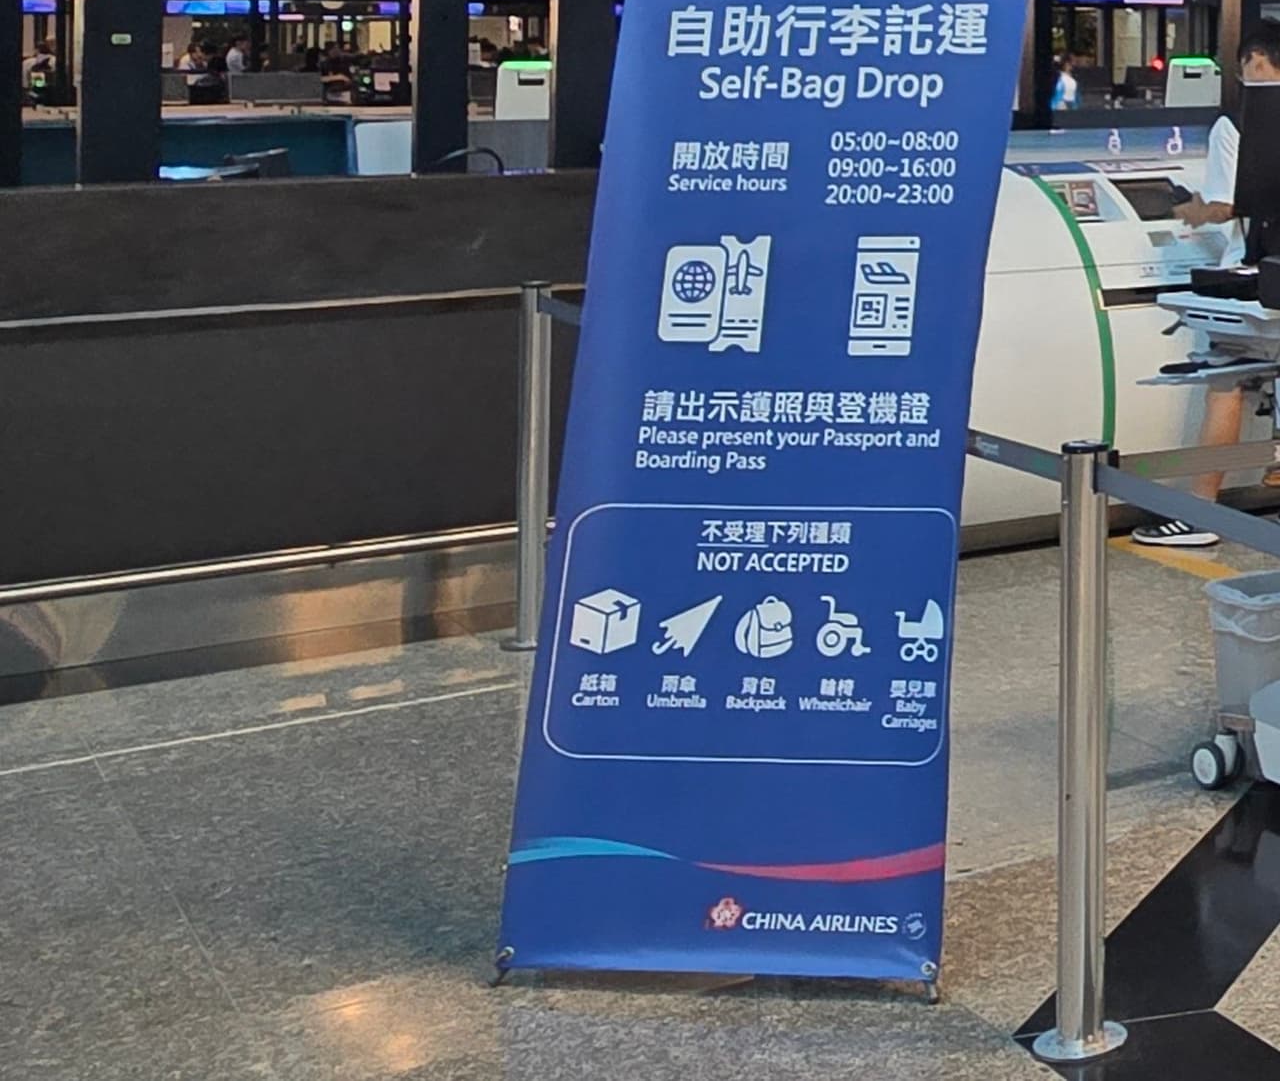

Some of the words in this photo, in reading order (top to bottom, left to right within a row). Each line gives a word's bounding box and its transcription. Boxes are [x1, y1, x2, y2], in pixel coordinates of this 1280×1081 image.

[667, 4, 989, 57] 自助行李託運
[699, 67, 845, 107] Self-Bag
[857, 69, 943, 107] Drop
[831, 131, 959, 151] 05:00~08:00
[672, 142, 790, 171] 開放時間
[828, 158, 956, 178] 09:00~16:00
[668, 174, 733, 192] Service
[737, 175, 787, 192] hours
[825, 184, 953, 205] 20:00~23:00
[642, 391, 931, 425] 請出示護照與登機證
[638, 427, 699, 446] Please
[702, 429, 773, 450] present
[776, 432, 819, 451] your
[823, 429, 902, 450] Passport
[906, 429, 940, 448] and
[635, 451, 721, 473] Boarding
[725, 452, 766, 471] Pass
[701, 520, 852, 545] 不受理下列種類
[697, 552, 742, 572] NOT
[744, 553, 850, 574] ACCEPTED
[579, 674, 617, 693] 紙箱
[661, 675, 696, 693] 雨傘
[741, 676, 776, 694] 背包
[820, 678, 855, 696] 輪椅
[571, 692, 620, 707] Carton
[646, 694, 707, 710] Umbrella
[725, 695, 786, 712] Backpack
[799, 697, 872, 713] Wheelchair
[895, 700, 926, 716] Baby
[882, 715, 938, 732] Carriages
[742, 912, 805, 932] CHINA
[809, 914, 898, 934] AIRLINES
